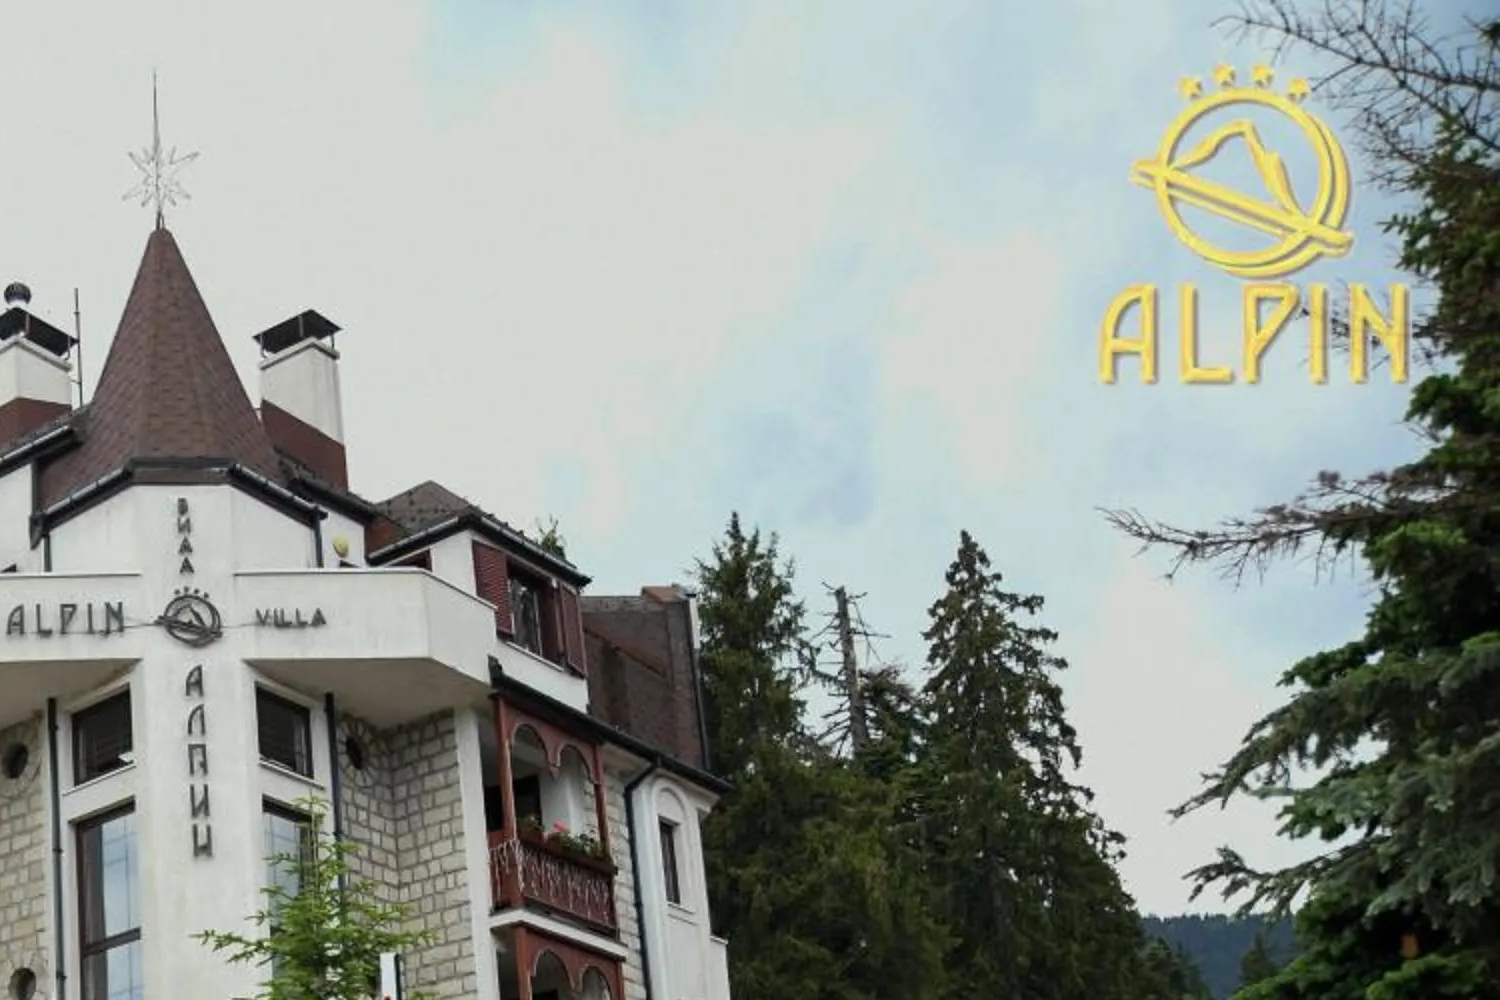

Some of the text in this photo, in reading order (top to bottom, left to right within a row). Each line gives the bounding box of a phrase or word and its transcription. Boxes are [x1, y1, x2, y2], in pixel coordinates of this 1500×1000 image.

[6, 601, 328, 636] ALPIN VILLA
[185, 664, 214, 858] АЛПИН
